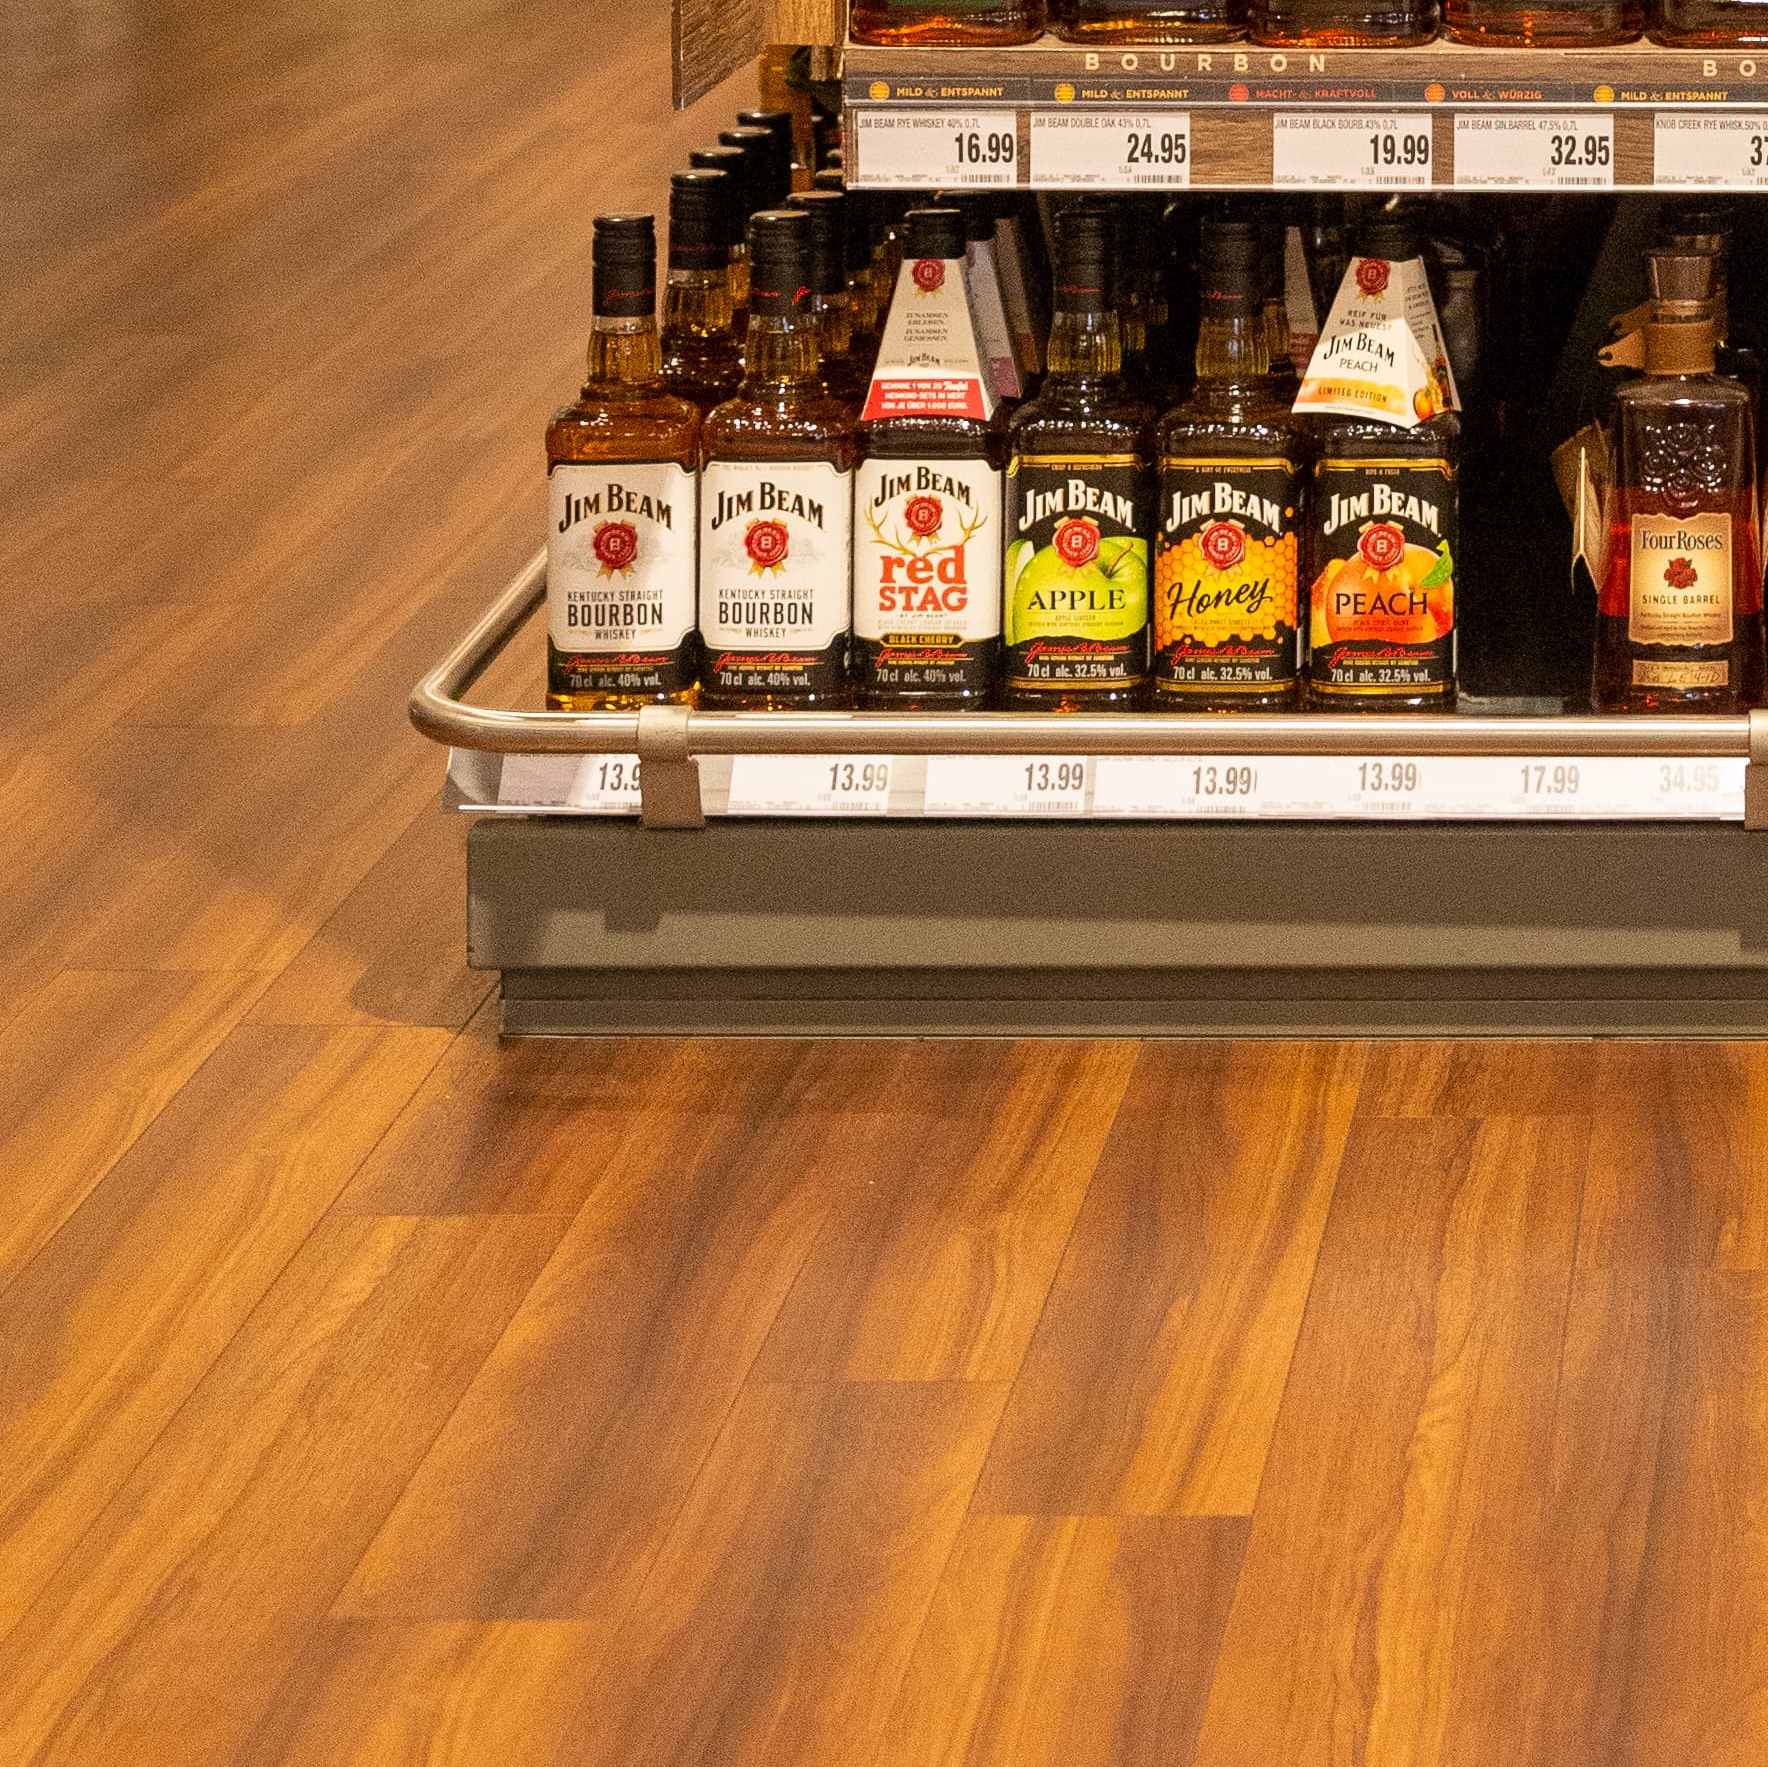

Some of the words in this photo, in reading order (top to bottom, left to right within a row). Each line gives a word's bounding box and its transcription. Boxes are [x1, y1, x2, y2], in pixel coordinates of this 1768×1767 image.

[1086, 54, 1326, 71] BOURBON
[954, 133, 1014, 164] 16.99
[1127, 133, 1186, 163] 24.95
[1370, 134, 1429, 165] 19.99
[1550, 136, 1610, 166] 32.95
[559, 492, 600, 533] JIM
[607, 483, 672, 532] BEAM
[879, 544, 965, 585] red
[880, 586, 967, 611] STAG
[1027, 588, 1126, 612] APPLE
[1168, 578, 1273, 620] Honey
[1335, 592, 1427, 616] PEACH
[568, 603, 663, 627] BOURBON
[829, 763, 888, 792] 13.99
[1024, 763, 1084, 791] 13.99
[1192, 766, 1253, 795] 13.99
[1358, 763, 1417, 791] 13.99
[1520, 766, 1579, 795] 17.99
